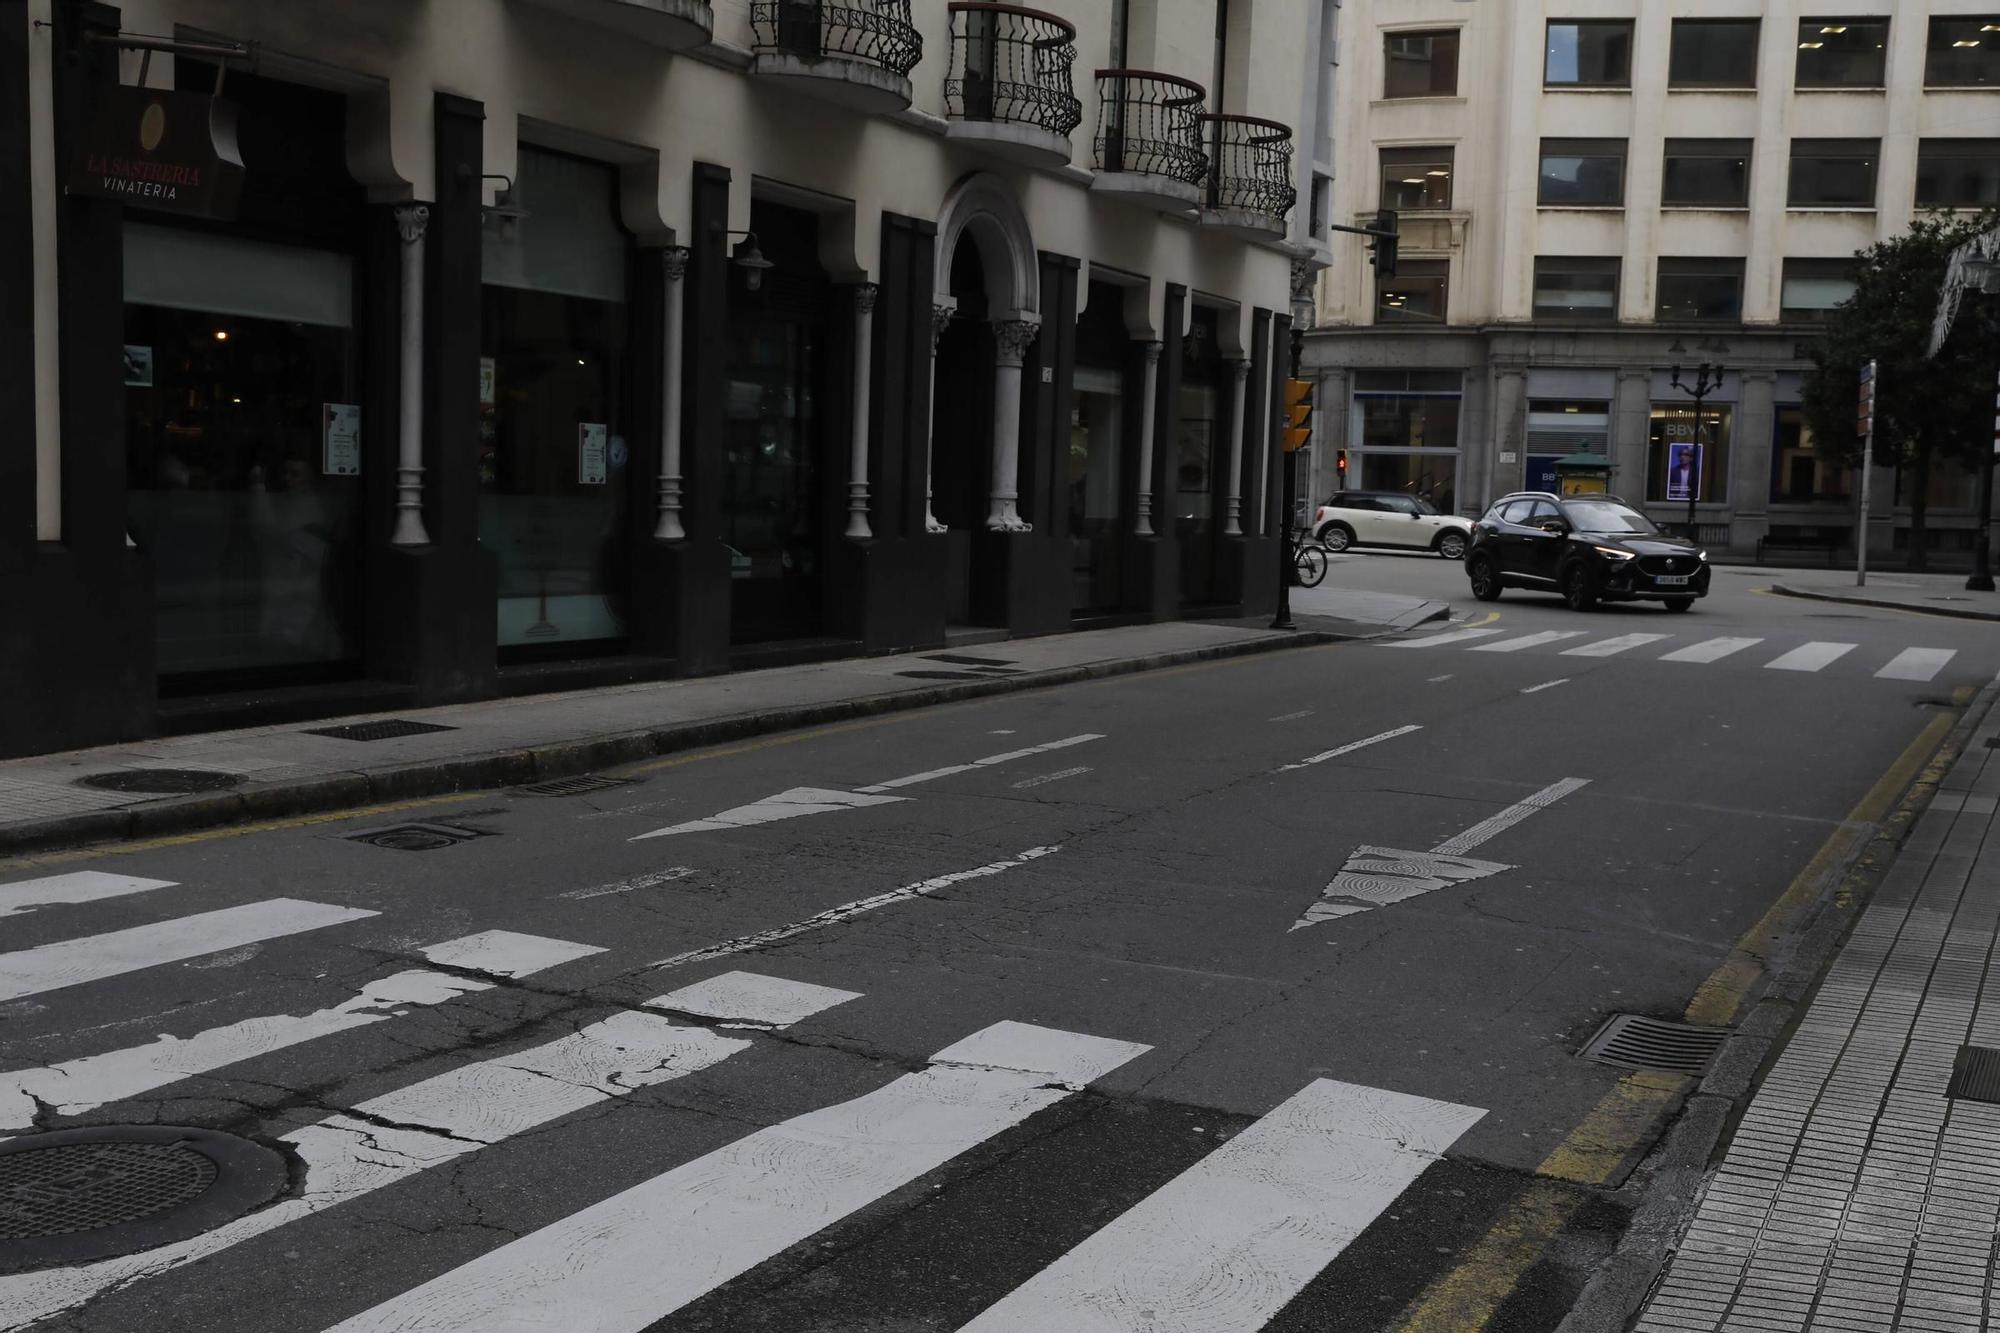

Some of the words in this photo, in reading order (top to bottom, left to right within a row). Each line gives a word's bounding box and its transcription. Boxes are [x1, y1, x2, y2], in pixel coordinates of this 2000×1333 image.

[104, 176, 177, 200] VINATERIA
[1666, 424, 1708, 436] BBVA
[1542, 473, 1556, 481] BB
